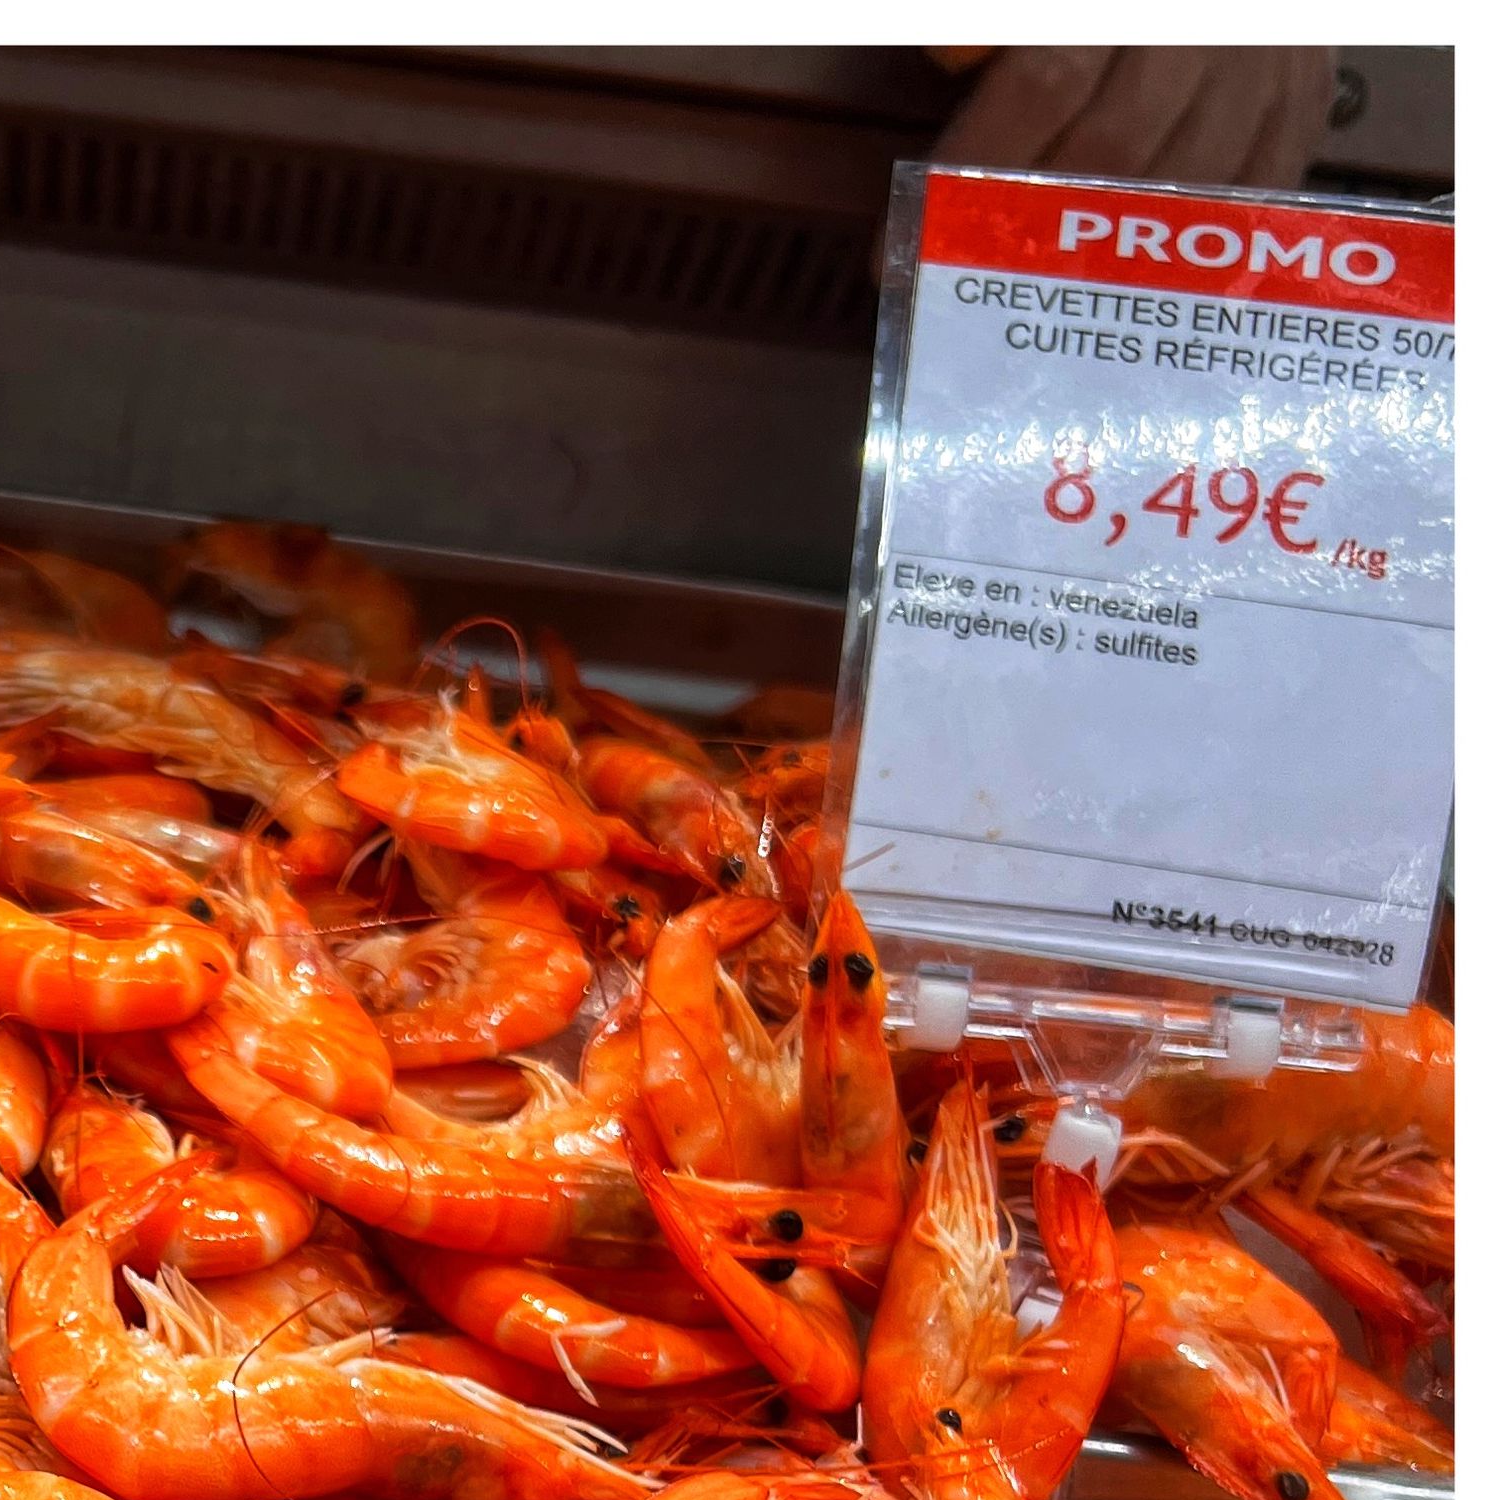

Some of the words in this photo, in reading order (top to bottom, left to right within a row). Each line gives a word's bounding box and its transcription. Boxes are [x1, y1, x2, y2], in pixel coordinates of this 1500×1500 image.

[1057, 208, 1397, 287] PROMO
[954, 275, 1181, 328] CREVETTES
[1191, 303, 1381, 352] ENTIERES
[1005, 320, 1143, 363] CUITES
[1043, 440, 1326, 554] 8,49€
[1330, 537, 1389, 580] /kg
[886, 598, 1068, 654] Allergène(s)
[1076, 629, 1086, 651] :
[1093, 630, 1199, 666] sulfites
[984, 580, 1021, 604] en
[1030, 585, 1040, 607] :
[1048, 586, 1200, 629] venezuela
